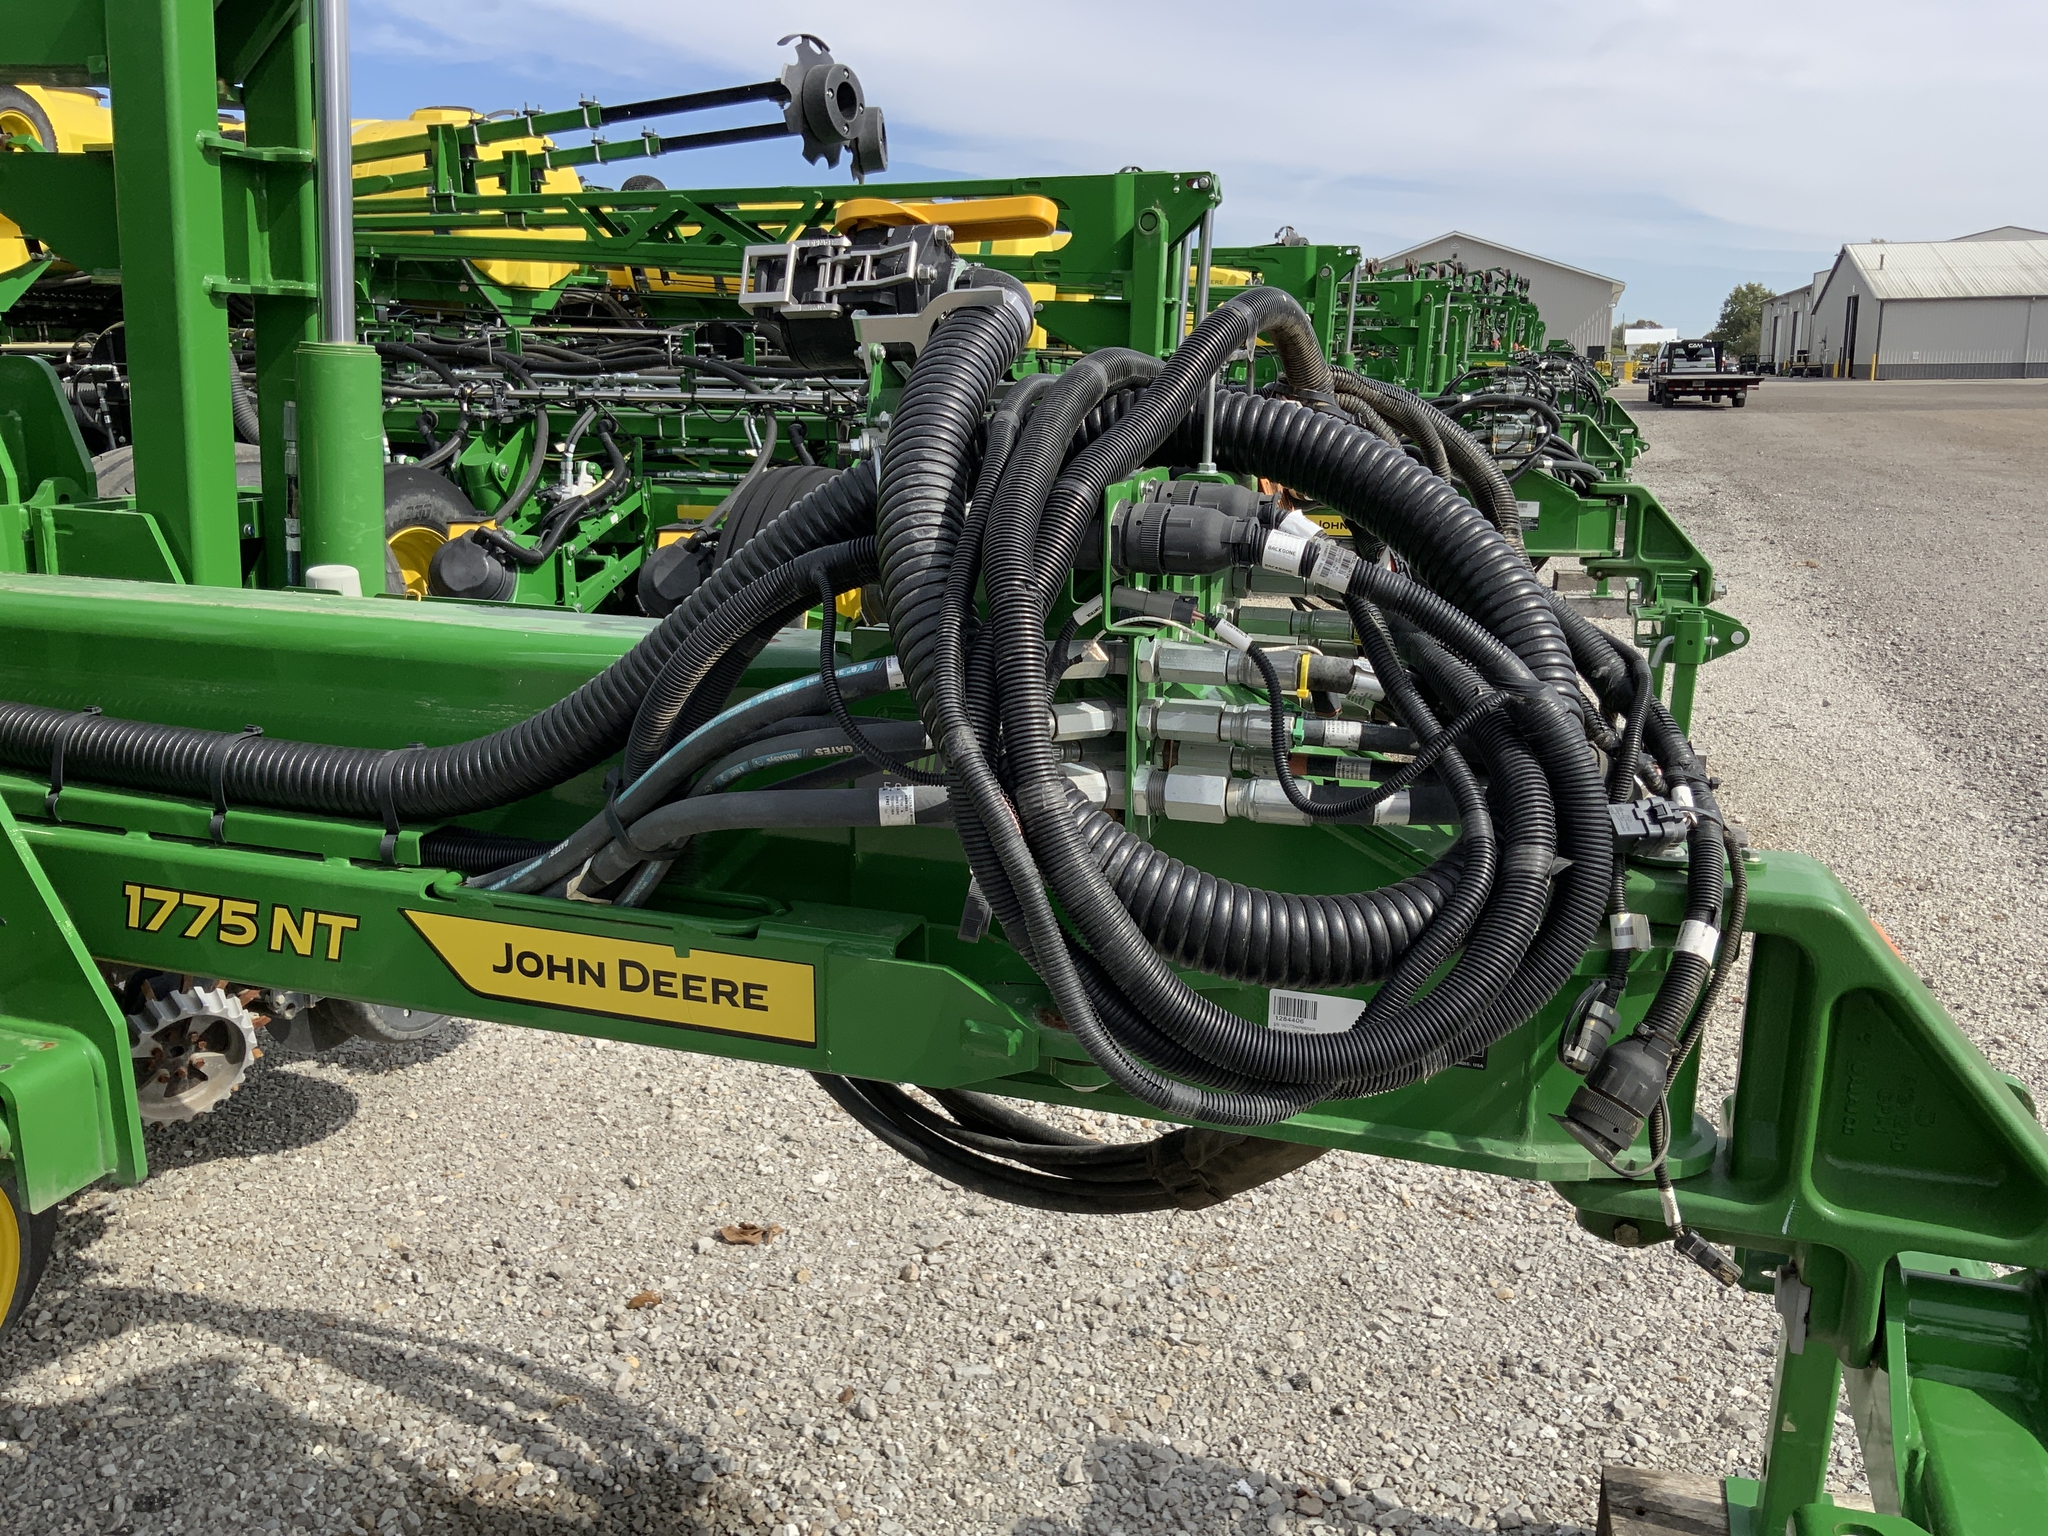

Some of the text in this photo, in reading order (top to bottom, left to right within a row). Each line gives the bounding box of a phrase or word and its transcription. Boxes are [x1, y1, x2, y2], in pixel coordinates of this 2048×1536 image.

[815, 745, 854, 757] GATES
[123, 881, 361, 962] 1775 NT
[492, 942, 769, 1012] JOHN DEERE
